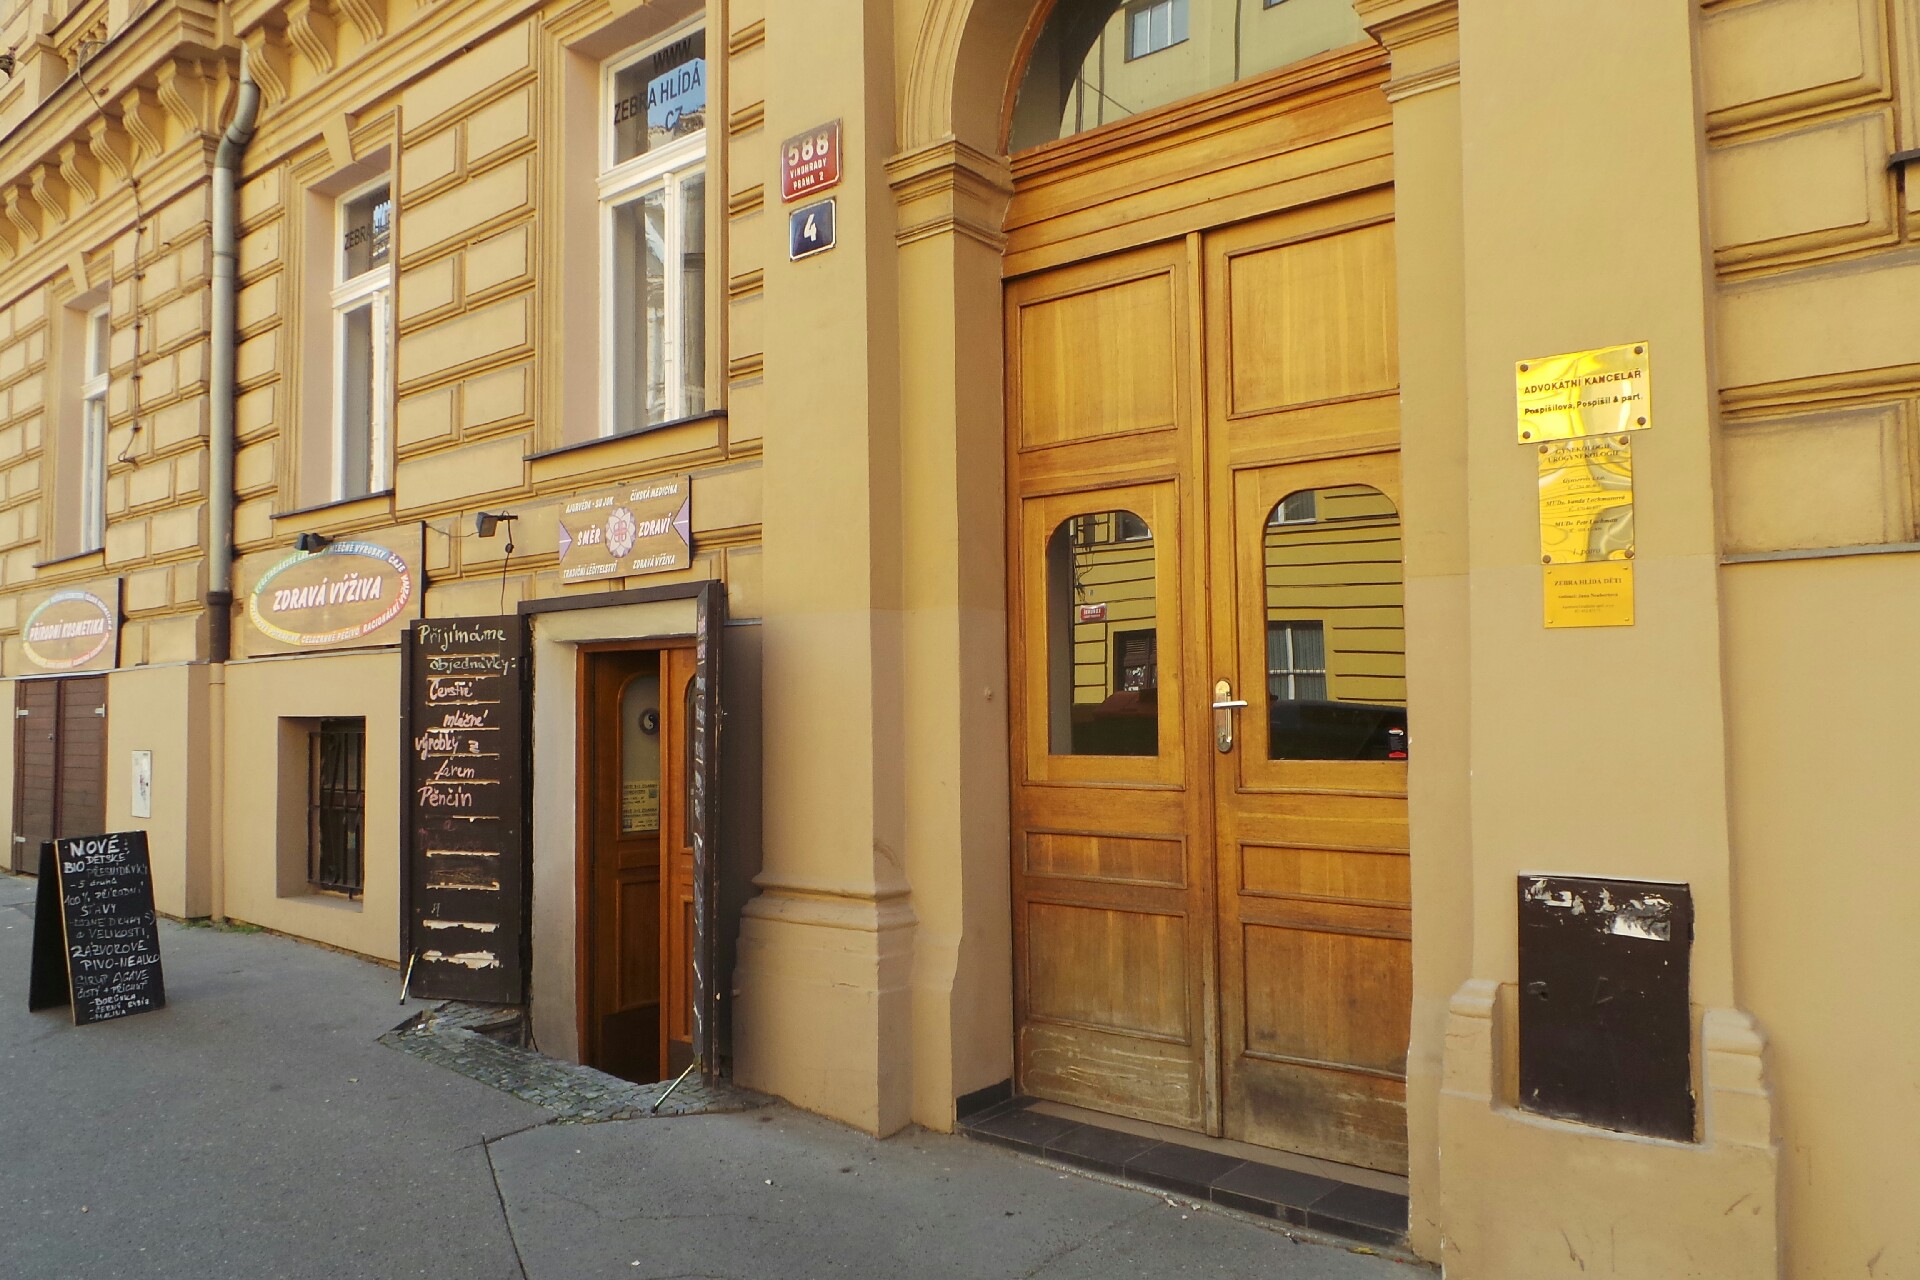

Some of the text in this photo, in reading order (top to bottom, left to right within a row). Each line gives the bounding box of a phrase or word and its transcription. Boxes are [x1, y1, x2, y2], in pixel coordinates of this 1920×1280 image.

[660, 61, 701, 104] HLÍDÁ
[788, 130, 829, 166] 588
[789, 157, 827, 179] VINOHRADY
[793, 171, 824, 190] PRAHA 2
[803, 213, 817, 242] 4
[1524, 375, 1581, 394] ADVOKÁTNÍ
[577, 524, 601, 546] SMĚR
[638, 511, 672, 538] ZDRAVÍ
[388, 553, 406, 573] ČAJE
[273, 572, 382, 612] ZDRAVÁ VÝŽIVA
[61, 618, 105, 638] KOSMETIKA
[418, 624, 507, 652] Přijímáme
[64, 861, 86, 874] BIO
